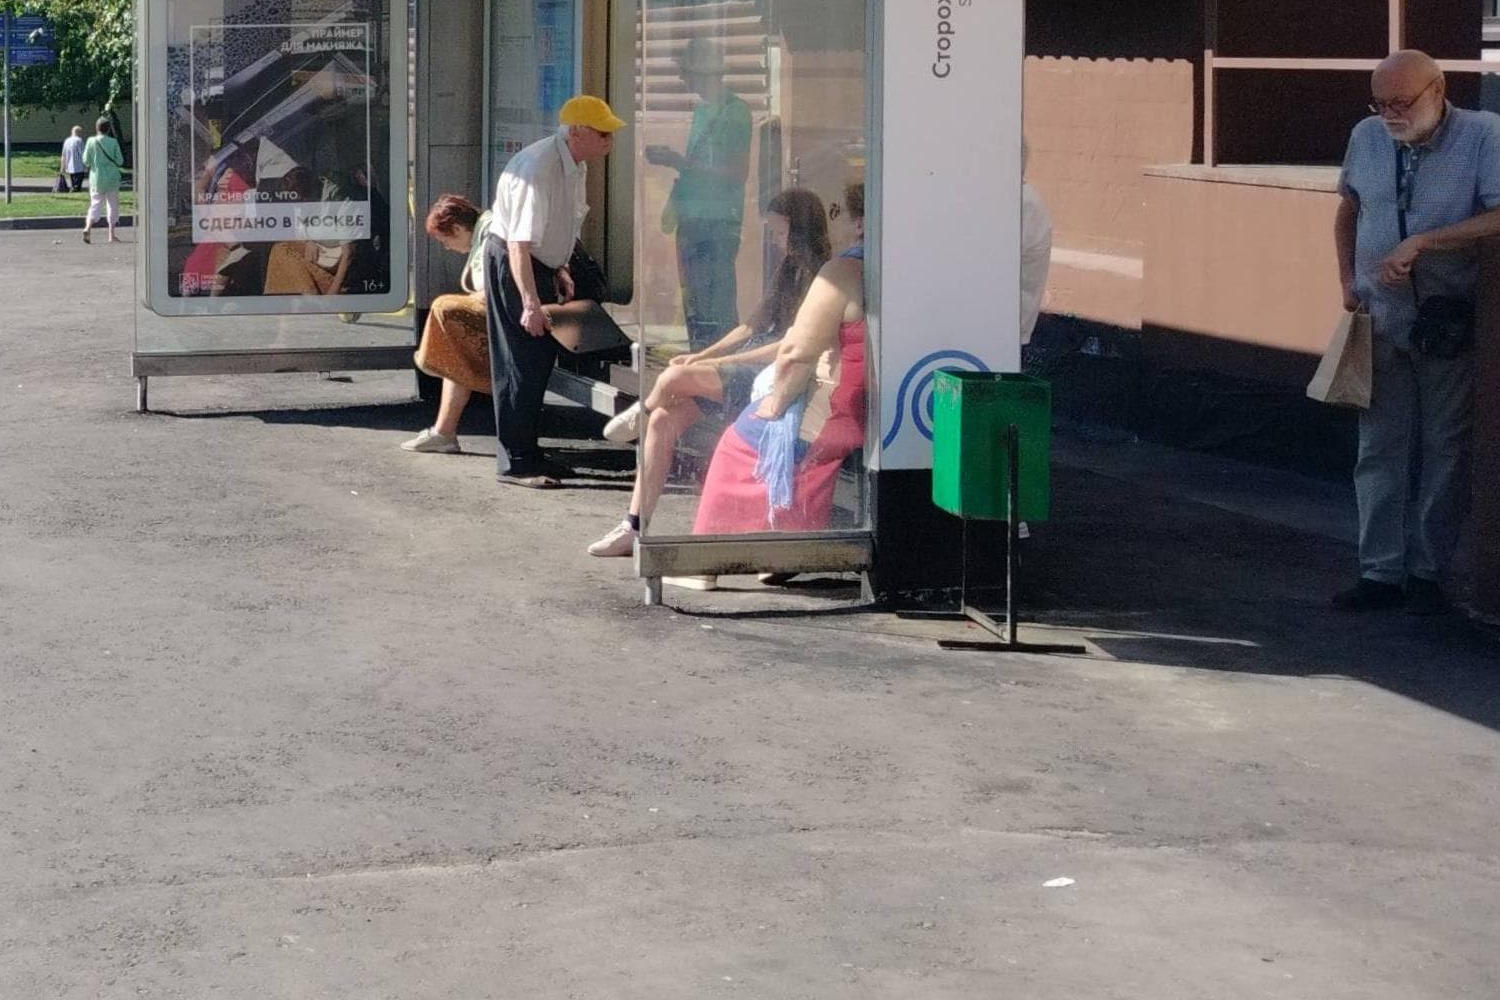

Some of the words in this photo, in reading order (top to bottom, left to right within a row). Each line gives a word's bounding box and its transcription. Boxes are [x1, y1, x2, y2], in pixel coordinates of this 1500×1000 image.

[311, 26, 365, 38] ПРАЙМЕР
[280, 40, 304, 52] ДЛЯ
[306, 40, 365, 51] МАКИЯЖА
[198, 191, 250, 202] КРАСИВО
[255, 191, 273, 202] ТО,
[275, 190, 298, 200] ЧТО
[198, 216, 277, 232] СДЕЛАНО
[283, 216, 292, 228] В
[296, 214, 365, 228] МОСКВЕ
[363, 279, 385, 292] 16+
